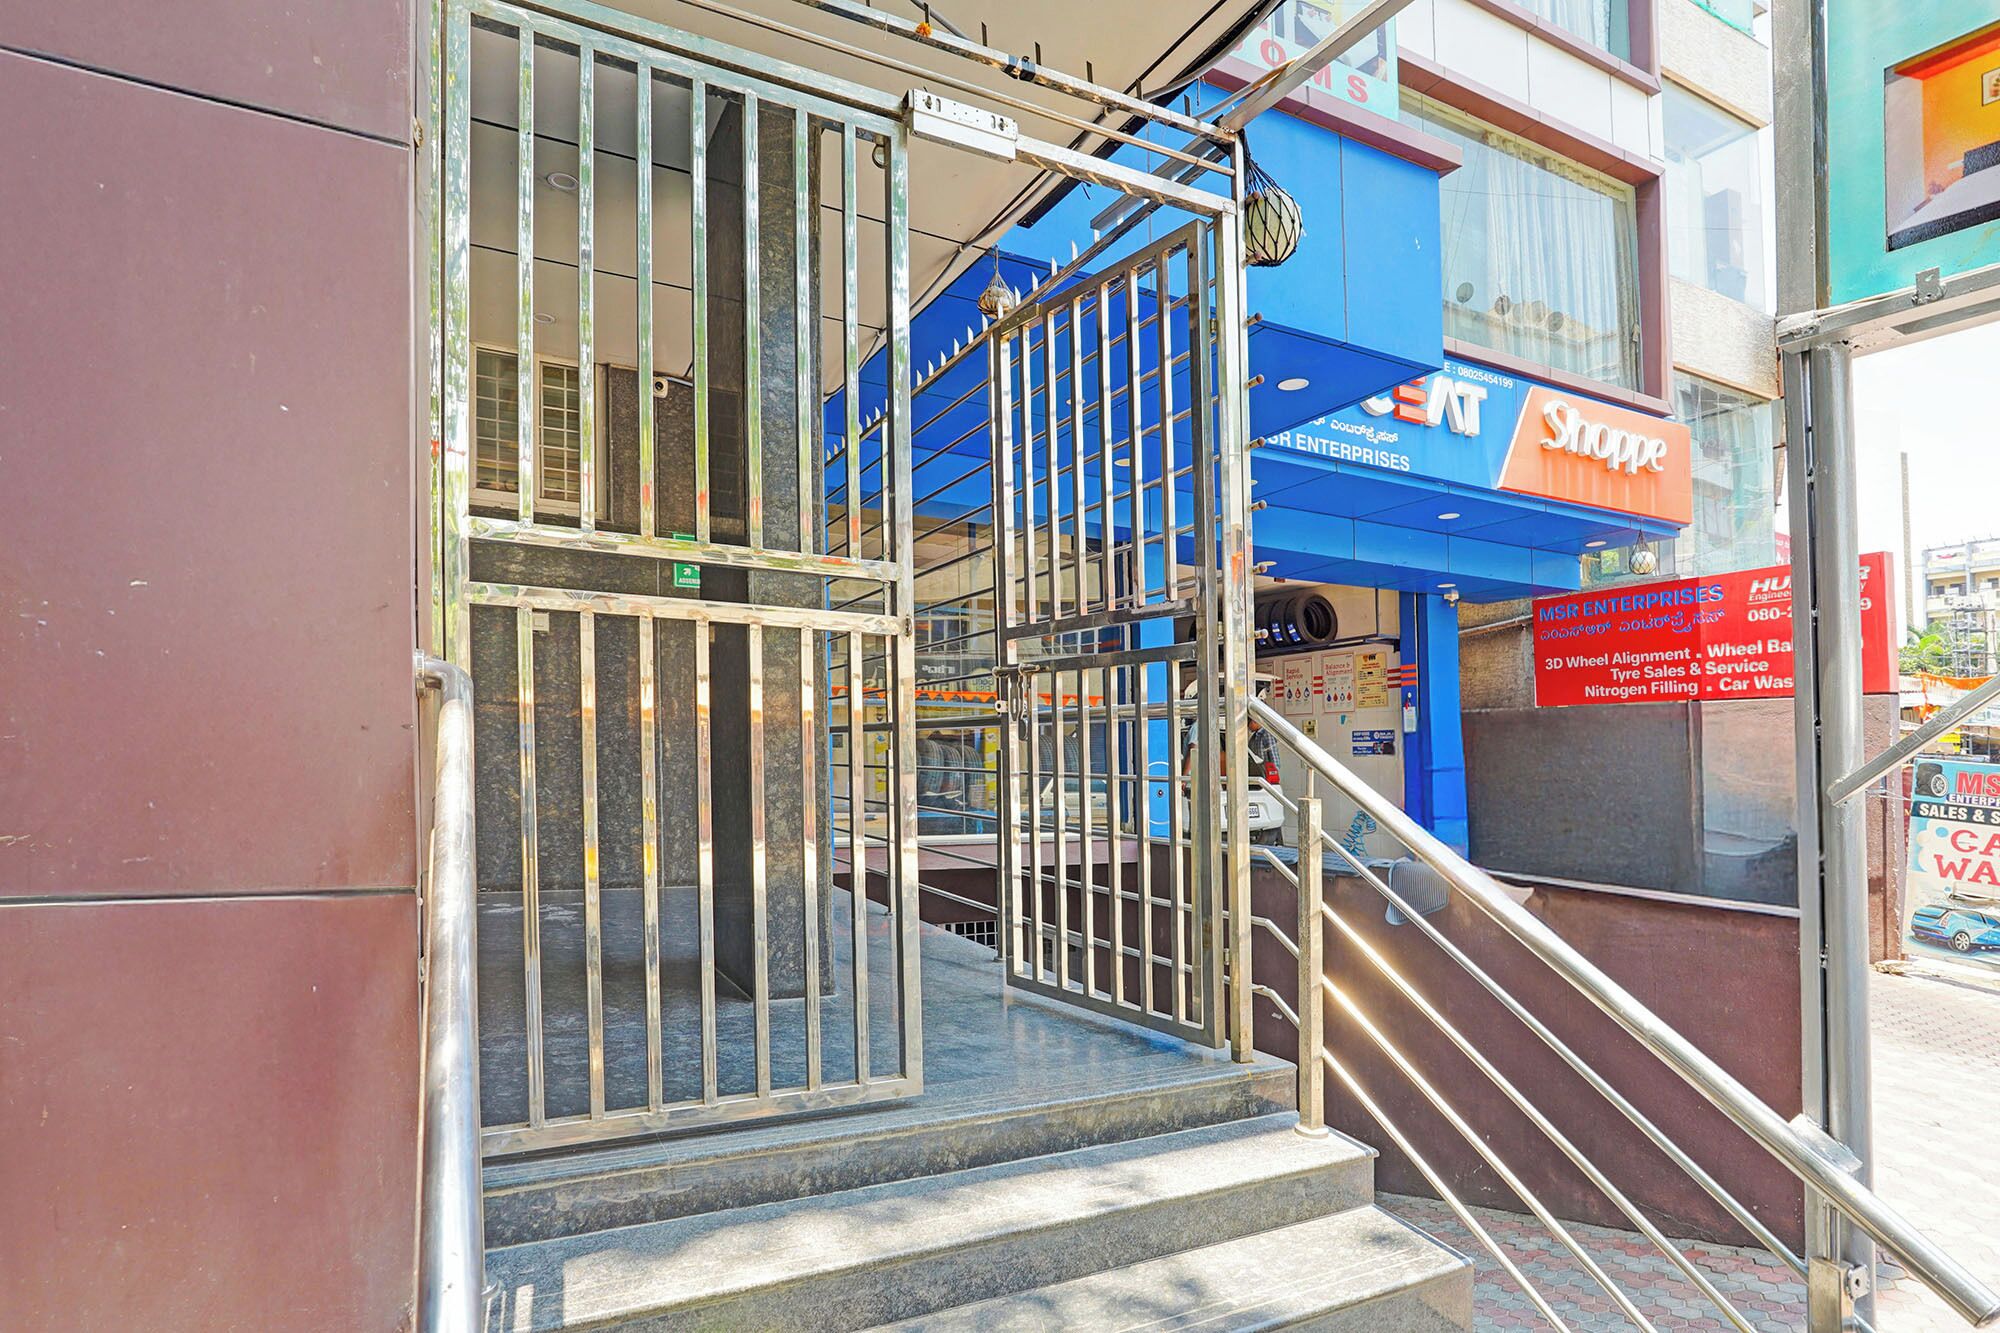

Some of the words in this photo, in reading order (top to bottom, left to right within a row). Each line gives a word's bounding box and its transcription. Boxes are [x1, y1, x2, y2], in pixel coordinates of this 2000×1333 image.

[1458, 367, 1513, 389] 08025454199
[1540, 400, 1667, 474] Shoppe
[1296, 433, 1411, 472] ENTERPRISES
[1539, 603, 1579, 622] MSR
[1583, 584, 1725, 617] ENTERPRISES
[1545, 657, 1563, 670] 3D
[1566, 653, 1609, 669] Wheel
[1612, 648, 1691, 666] Alignment
[1707, 639, 1762, 657] Wheel
[1610, 667, 1641, 683] Tyre
[1643, 664, 1686, 679] Sales
[1689, 662, 1701, 676] &
[1705, 658, 1769, 675] Service
[1585, 683, 1647, 699] Nitrogen
[1651, 680, 1698, 696] Filling
[1719, 676, 1750, 692] Car
[1754, 674, 1794, 689] Was
[1956, 771, 2000, 797] MS
[1919, 803, 1968, 821] SALES
[1972, 808, 1985, 823] &
[1950, 829, 2000, 858] CA
[1933, 854, 2000, 886] WA
